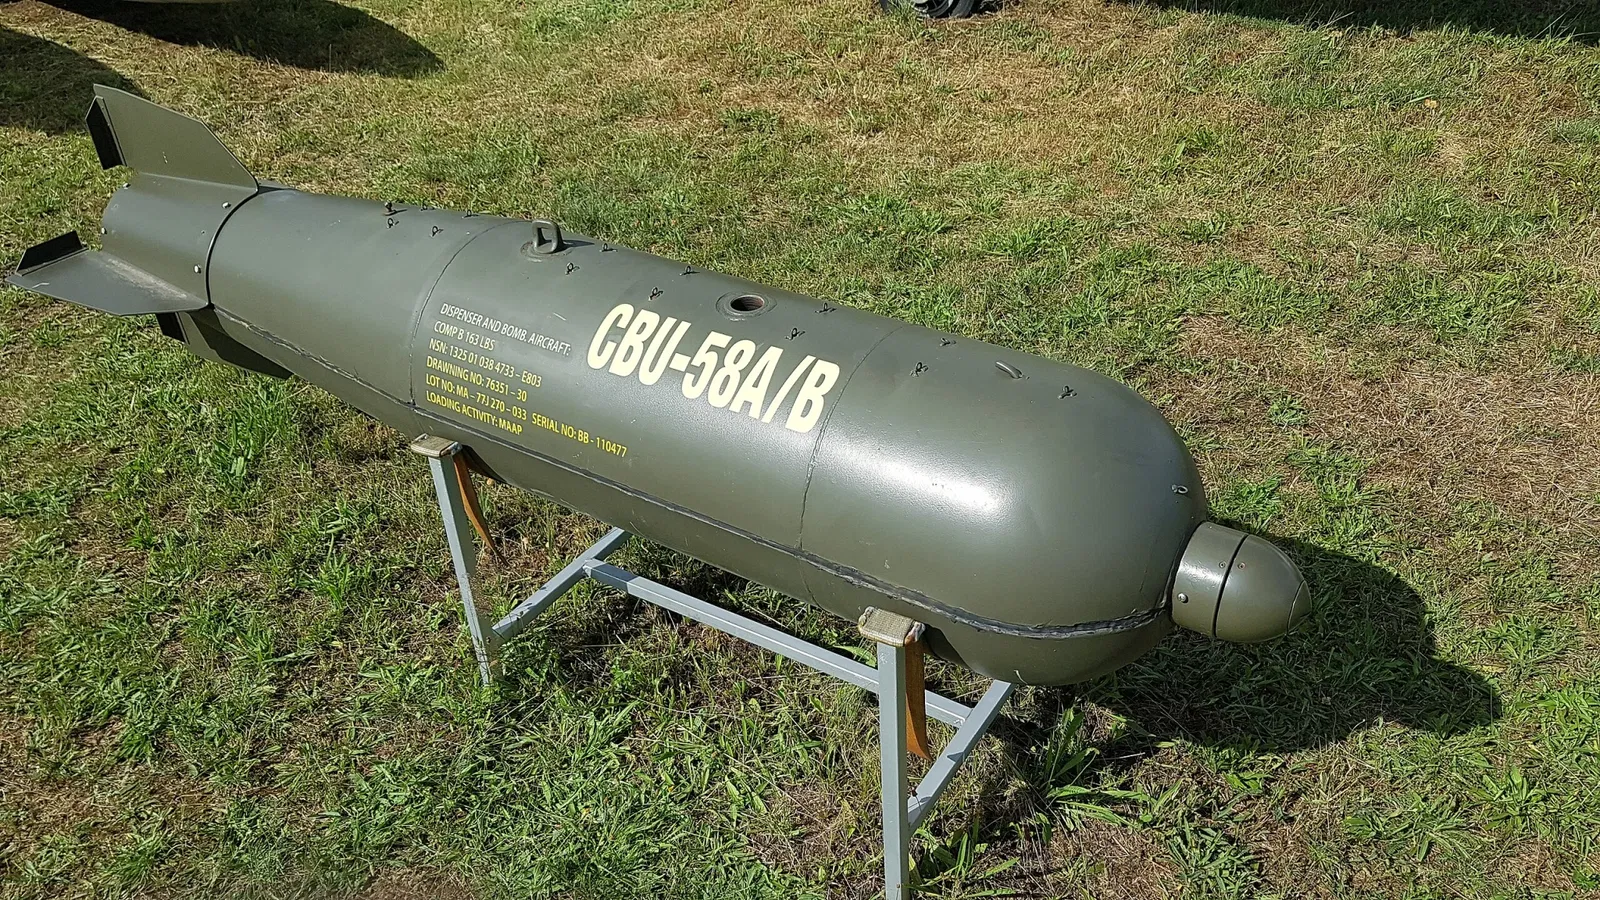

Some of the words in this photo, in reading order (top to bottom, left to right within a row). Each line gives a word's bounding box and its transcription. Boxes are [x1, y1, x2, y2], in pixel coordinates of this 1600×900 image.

[434, 321, 458, 338] COMP
[458, 329, 464, 340] B
[465, 332, 480, 346] 163
[480, 336, 495, 351] LBS
[440, 303, 483, 325] DISPENSER
[482, 318, 501, 332] AND
[501, 324, 527, 342] BOMB.
[528, 333, 571, 356] AIRCRAFT:
[426, 355, 469, 381] DRAWNING
[470, 371, 484, 387] NO:
[485, 377, 509, 395] 76351
[517, 388, 527, 402] 30
[429, 338, 448, 355] NSN:
[449, 345, 468, 361] 1325
[468, 353, 477, 365] 01
[479, 356, 494, 370] 038
[494, 362, 515, 378] 4733
[521, 370, 542, 388] E803
[587, 303, 840, 434] CBU-58A/B
[426, 390, 461, 412] LOADING
[461, 404, 498, 427] ACTIVITY:
[499, 417, 523, 435] MAAP
[426, 373, 440, 388] LOT
[441, 379, 456, 394] NO:
[456, 384, 469, 399] MA
[476, 392, 489, 406] 77J
[491, 399, 505, 413] 270
[512, 406, 527, 420] 033
[532, 412, 560, 433] SERIAL
[561, 423, 576, 439] NO:
[578, 429, 589, 444] BB
[596, 437, 627, 458] 110477
